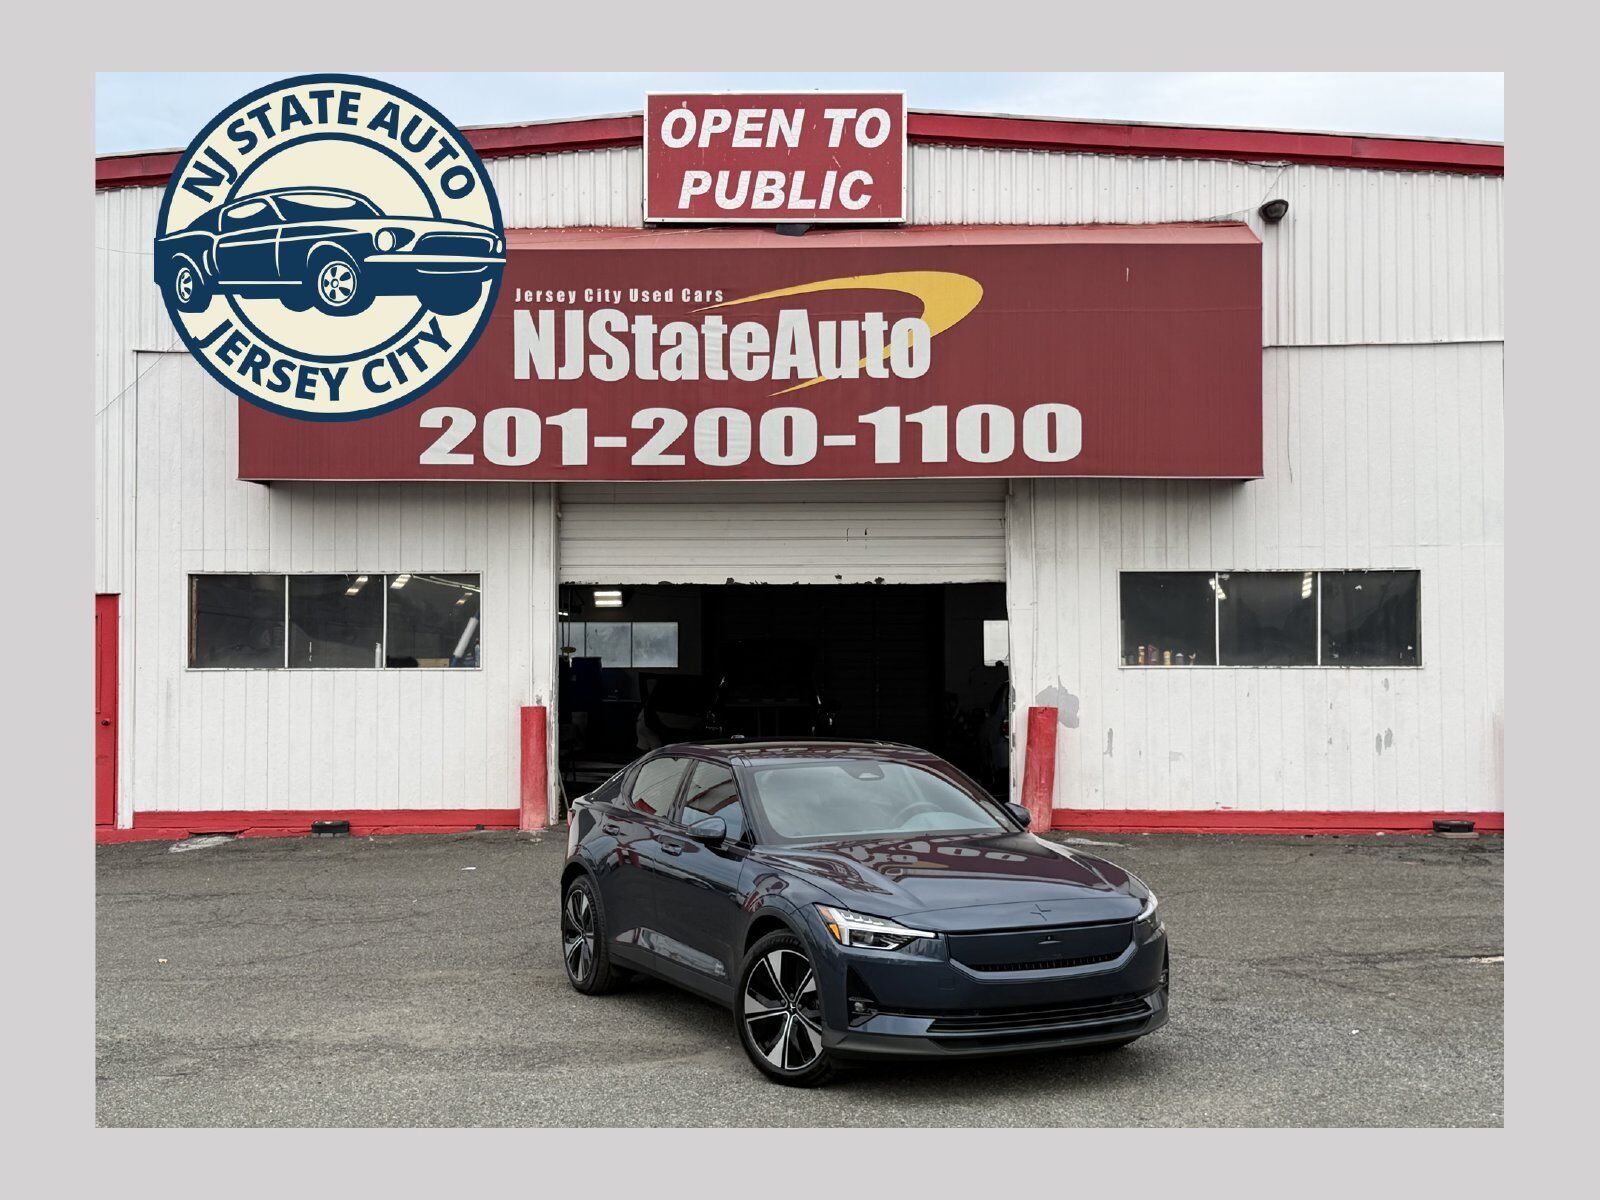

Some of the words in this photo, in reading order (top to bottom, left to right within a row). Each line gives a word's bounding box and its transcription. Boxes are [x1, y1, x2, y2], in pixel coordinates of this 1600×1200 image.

[661, 108, 805, 148] OPEN
[824, 107, 890, 148] TO
[678, 170, 873, 210] PUBLIC
[514, 288, 576, 305] Jersey
[585, 288, 622, 305] City
[630, 288, 674, 303] Used
[682, 288, 724, 303] Cars
[513, 309, 932, 382] NJStateAuto
[420, 403, 1083, 467] 201-200-1100
